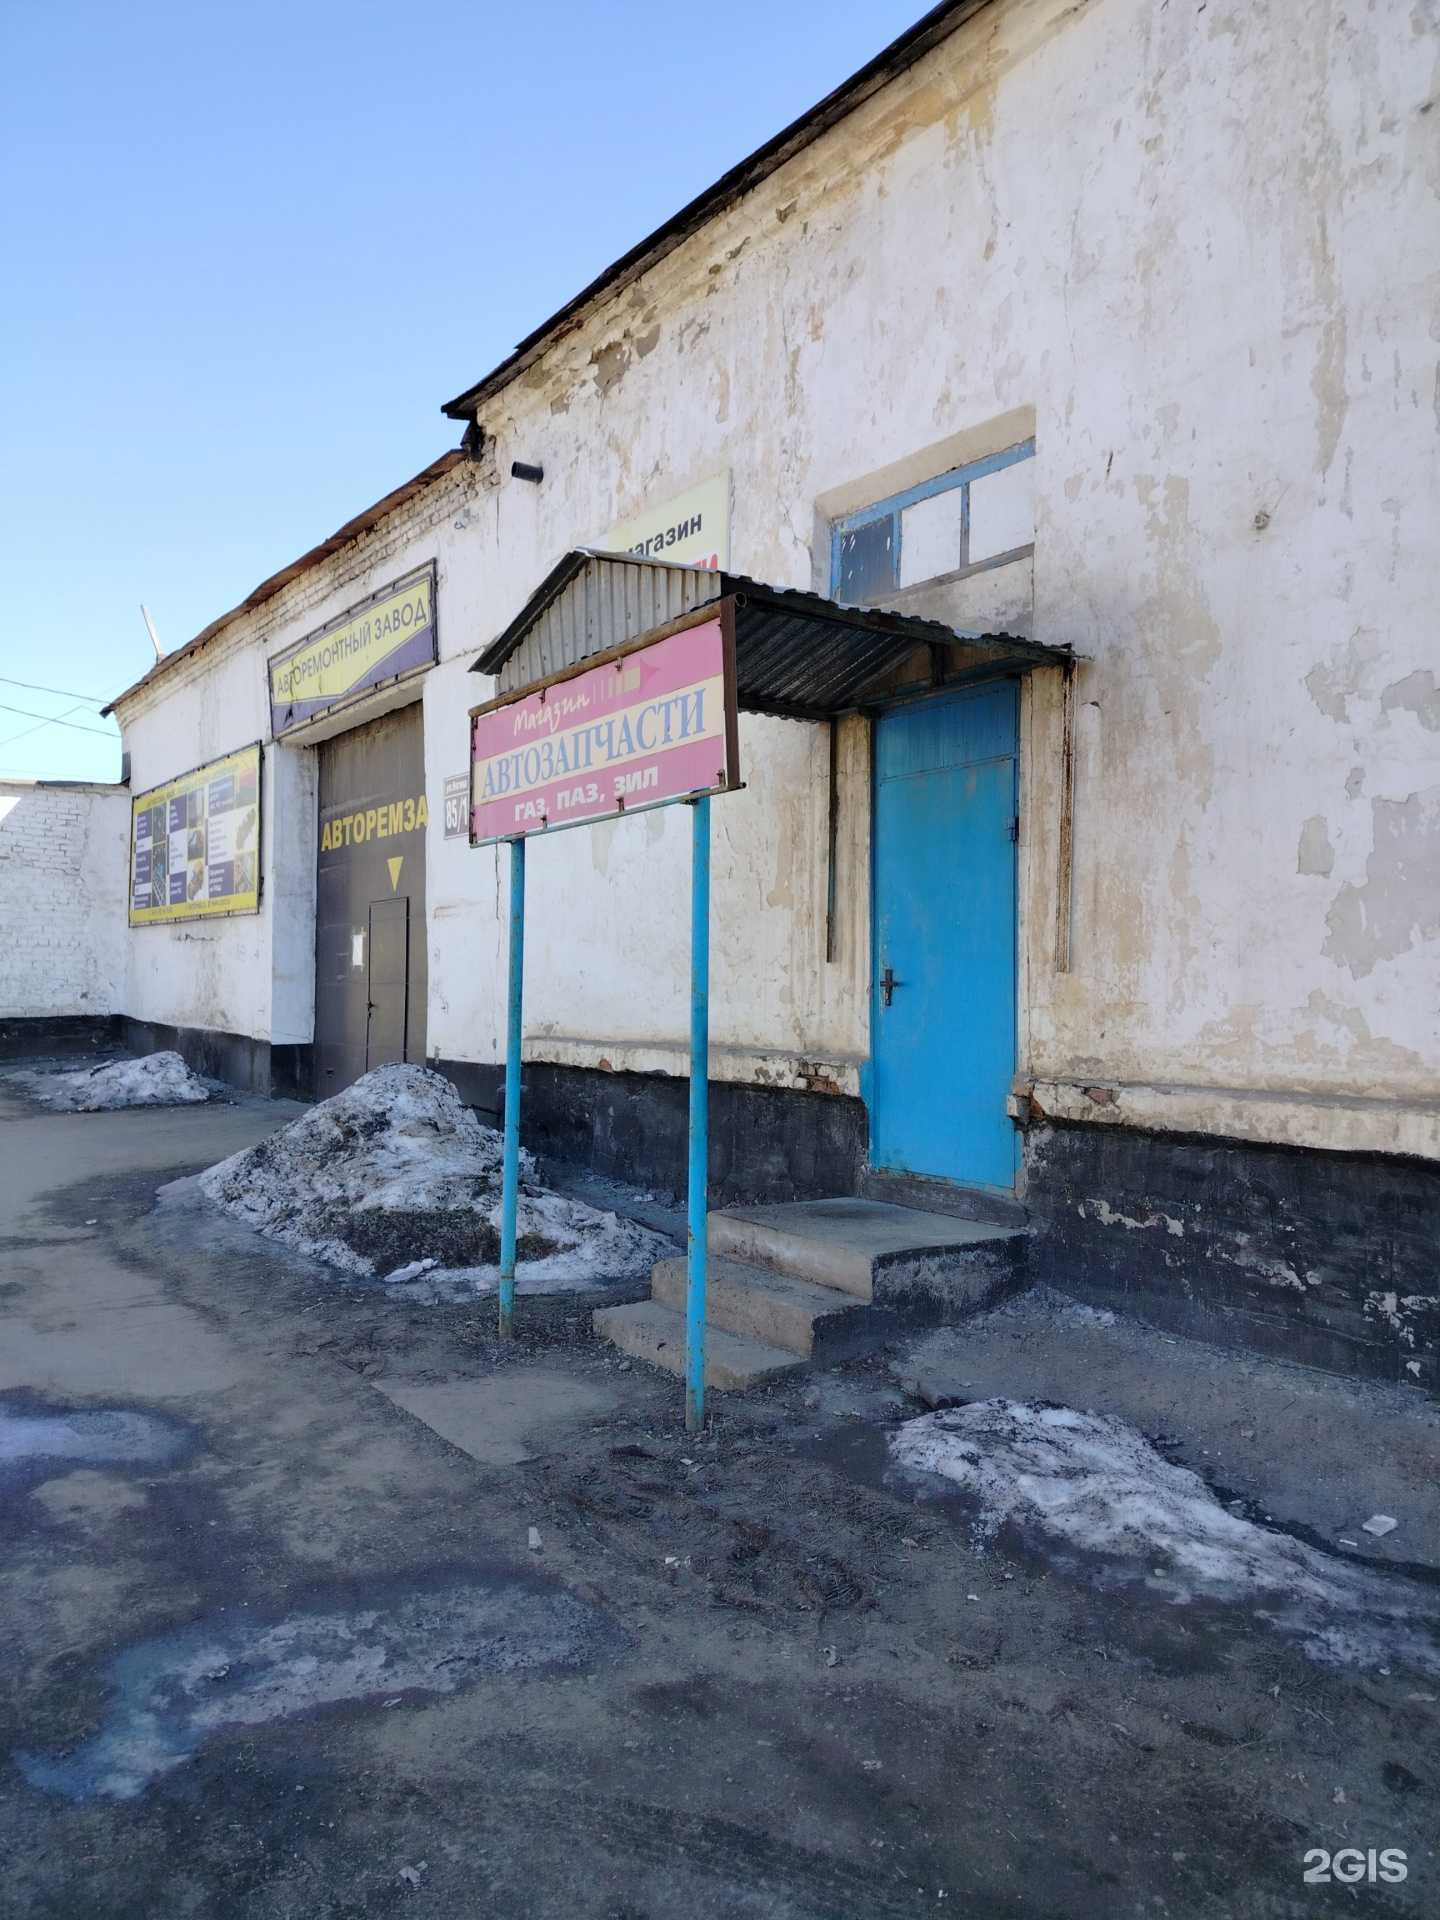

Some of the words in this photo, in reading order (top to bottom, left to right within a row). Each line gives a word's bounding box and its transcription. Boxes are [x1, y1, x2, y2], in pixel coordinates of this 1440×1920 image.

[628, 513, 702, 557] агазин
[277, 620, 371, 696] АВТОРЕМОНТНЫЙ
[375, 598, 426, 641] ЗАВОД
[514, 691, 590, 736] Магазин
[481, 688, 706, 799] АВТОЗАПЧАСТИ
[613, 766, 659, 797] ЗИЛ
